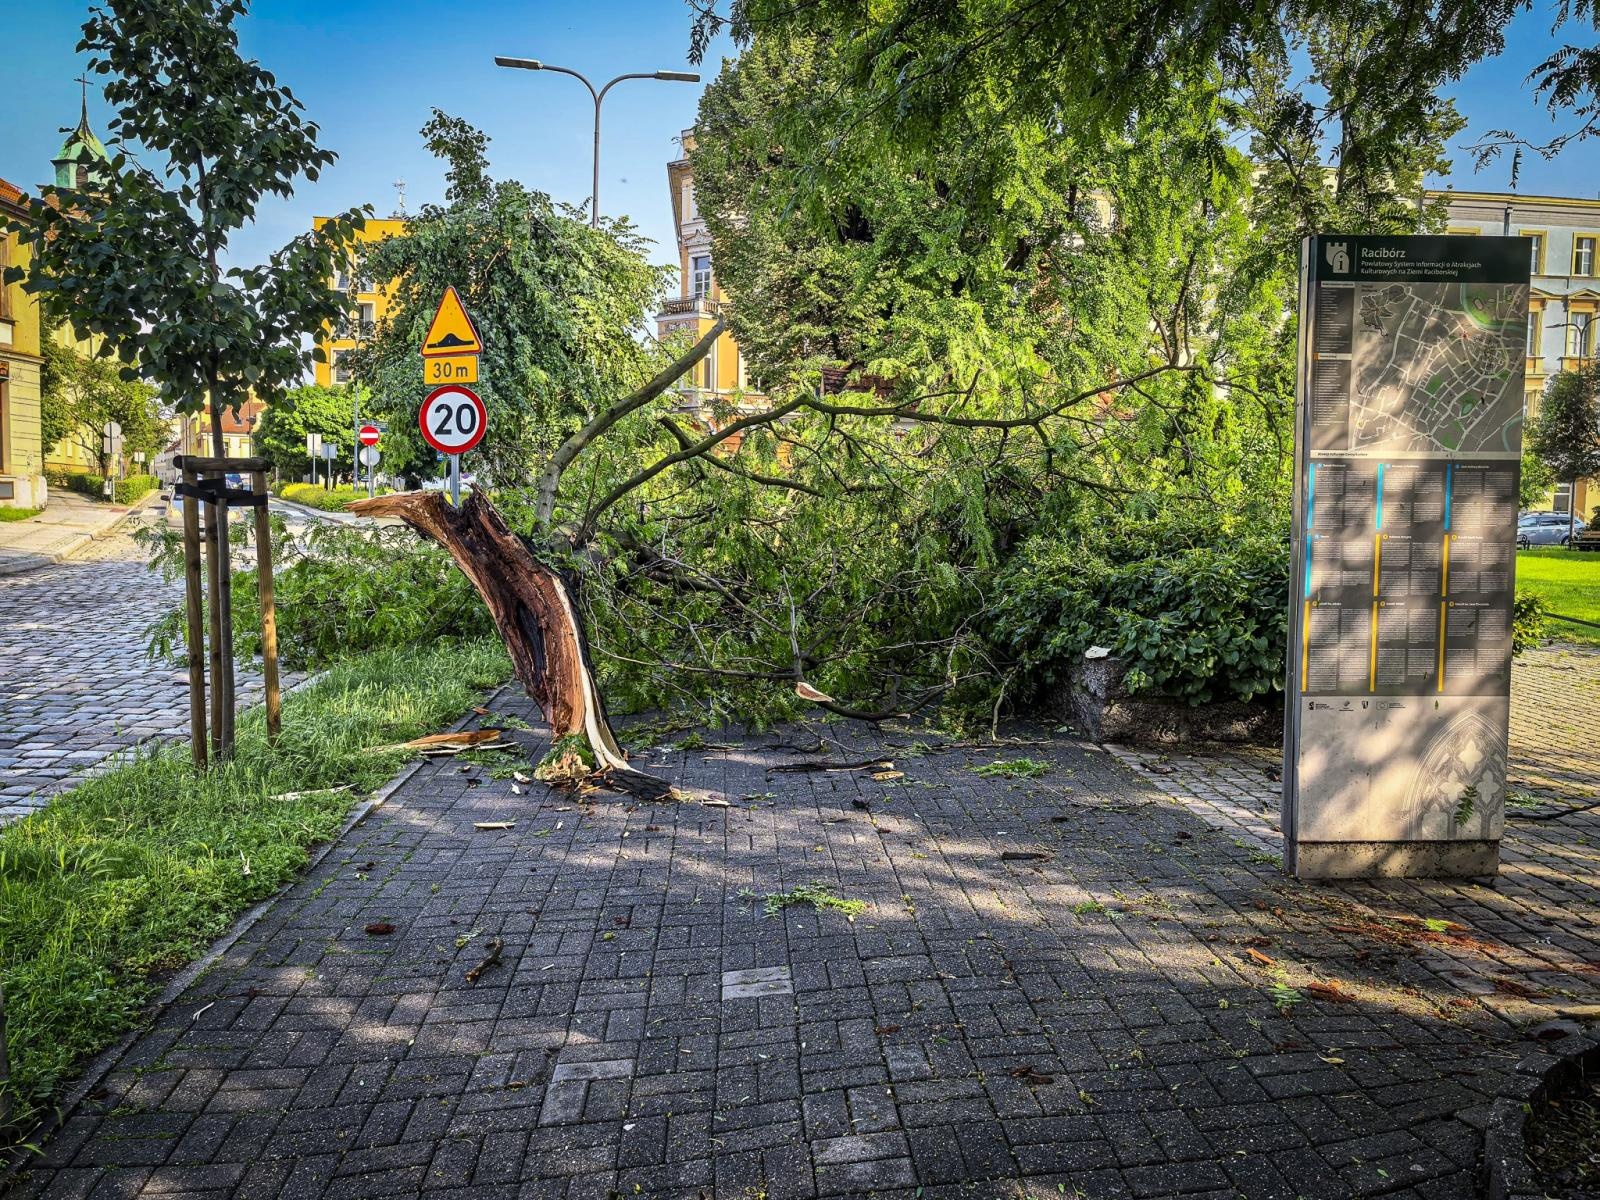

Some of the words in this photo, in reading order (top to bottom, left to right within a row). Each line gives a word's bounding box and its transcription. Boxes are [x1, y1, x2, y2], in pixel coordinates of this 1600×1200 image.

[1361, 247, 1406, 258] Racibórz
[1361, 260, 1393, 268] Powiatowy
[1394, 260, 1415, 269] System
[1416, 261, 1445, 269] Informacji
[1451, 261, 1482, 270] Atrakcjach
[1361, 268, 1398, 276] Kulturowych
[1424, 269, 1459, 277] Raciborskiej
[433, 362, 452, 378] 30
[456, 366, 468, 377] m
[434, 403, 476, 435] 20
